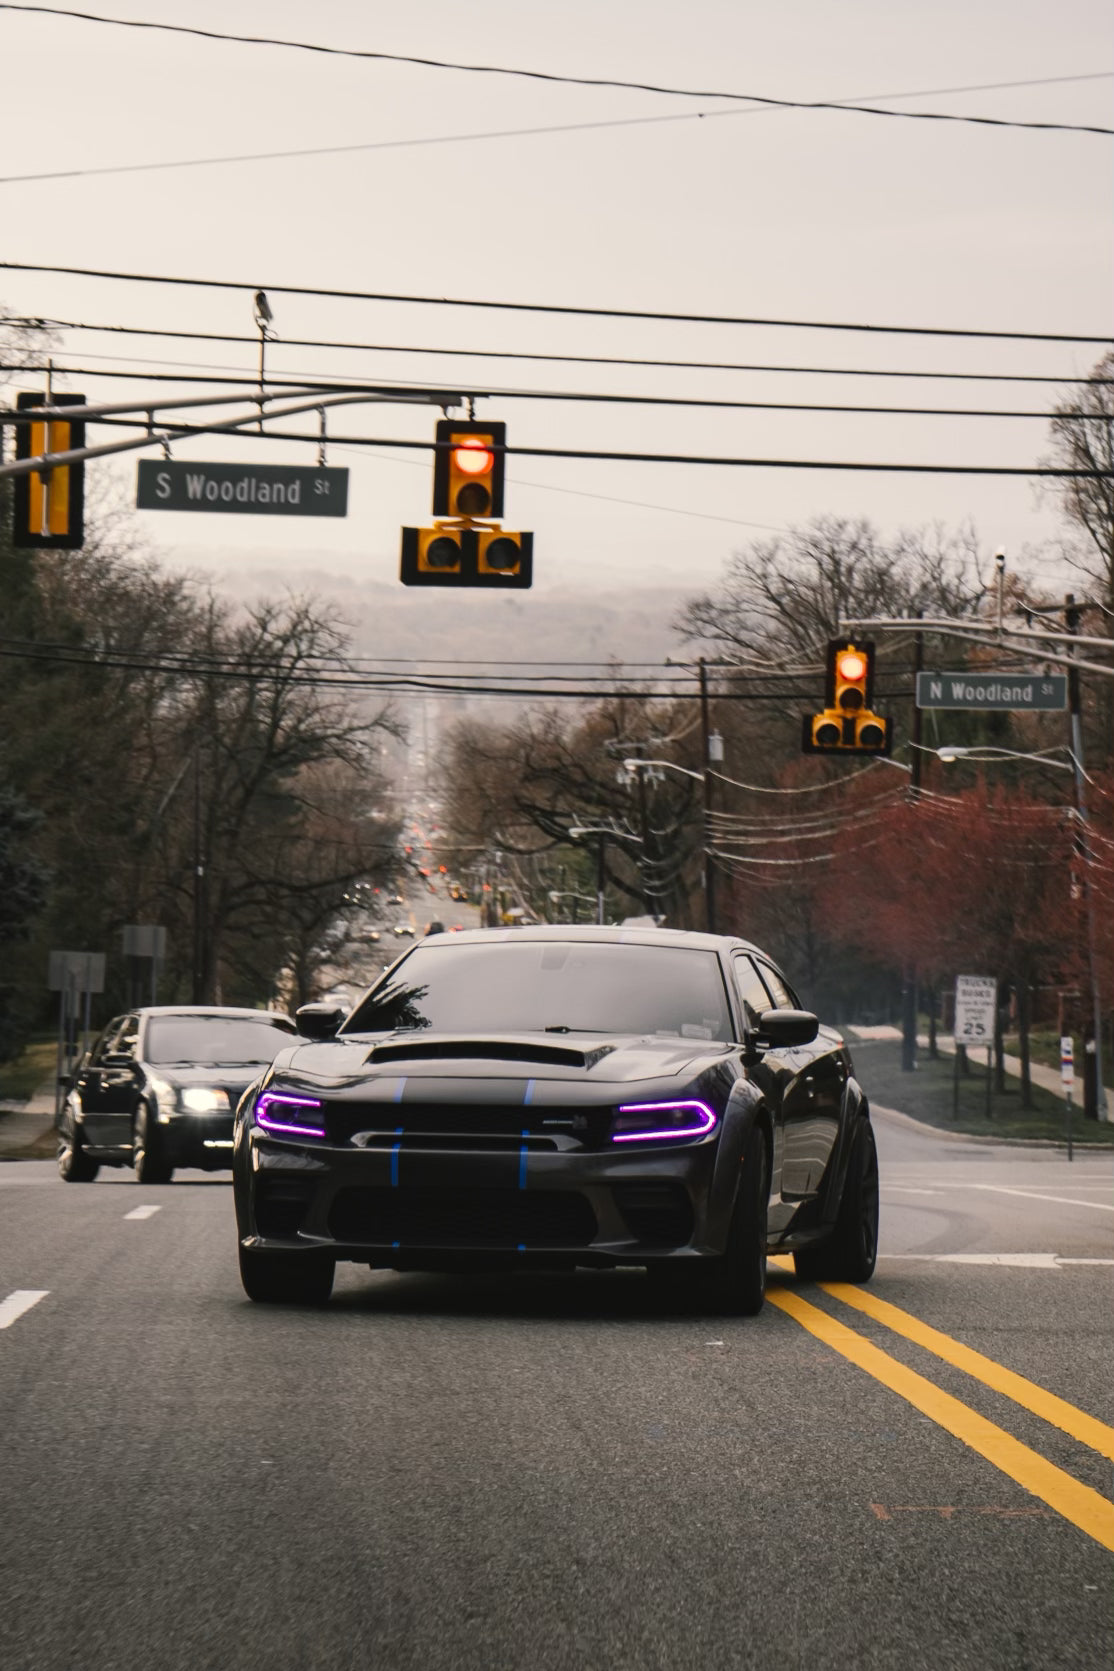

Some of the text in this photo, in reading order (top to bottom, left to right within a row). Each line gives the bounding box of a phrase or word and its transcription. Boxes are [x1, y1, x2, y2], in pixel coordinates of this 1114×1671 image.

[155, 472, 331, 504] S Woodland St
[929, 681, 1054, 702] N Woodland St
[963, 1022, 986, 1036] 25
